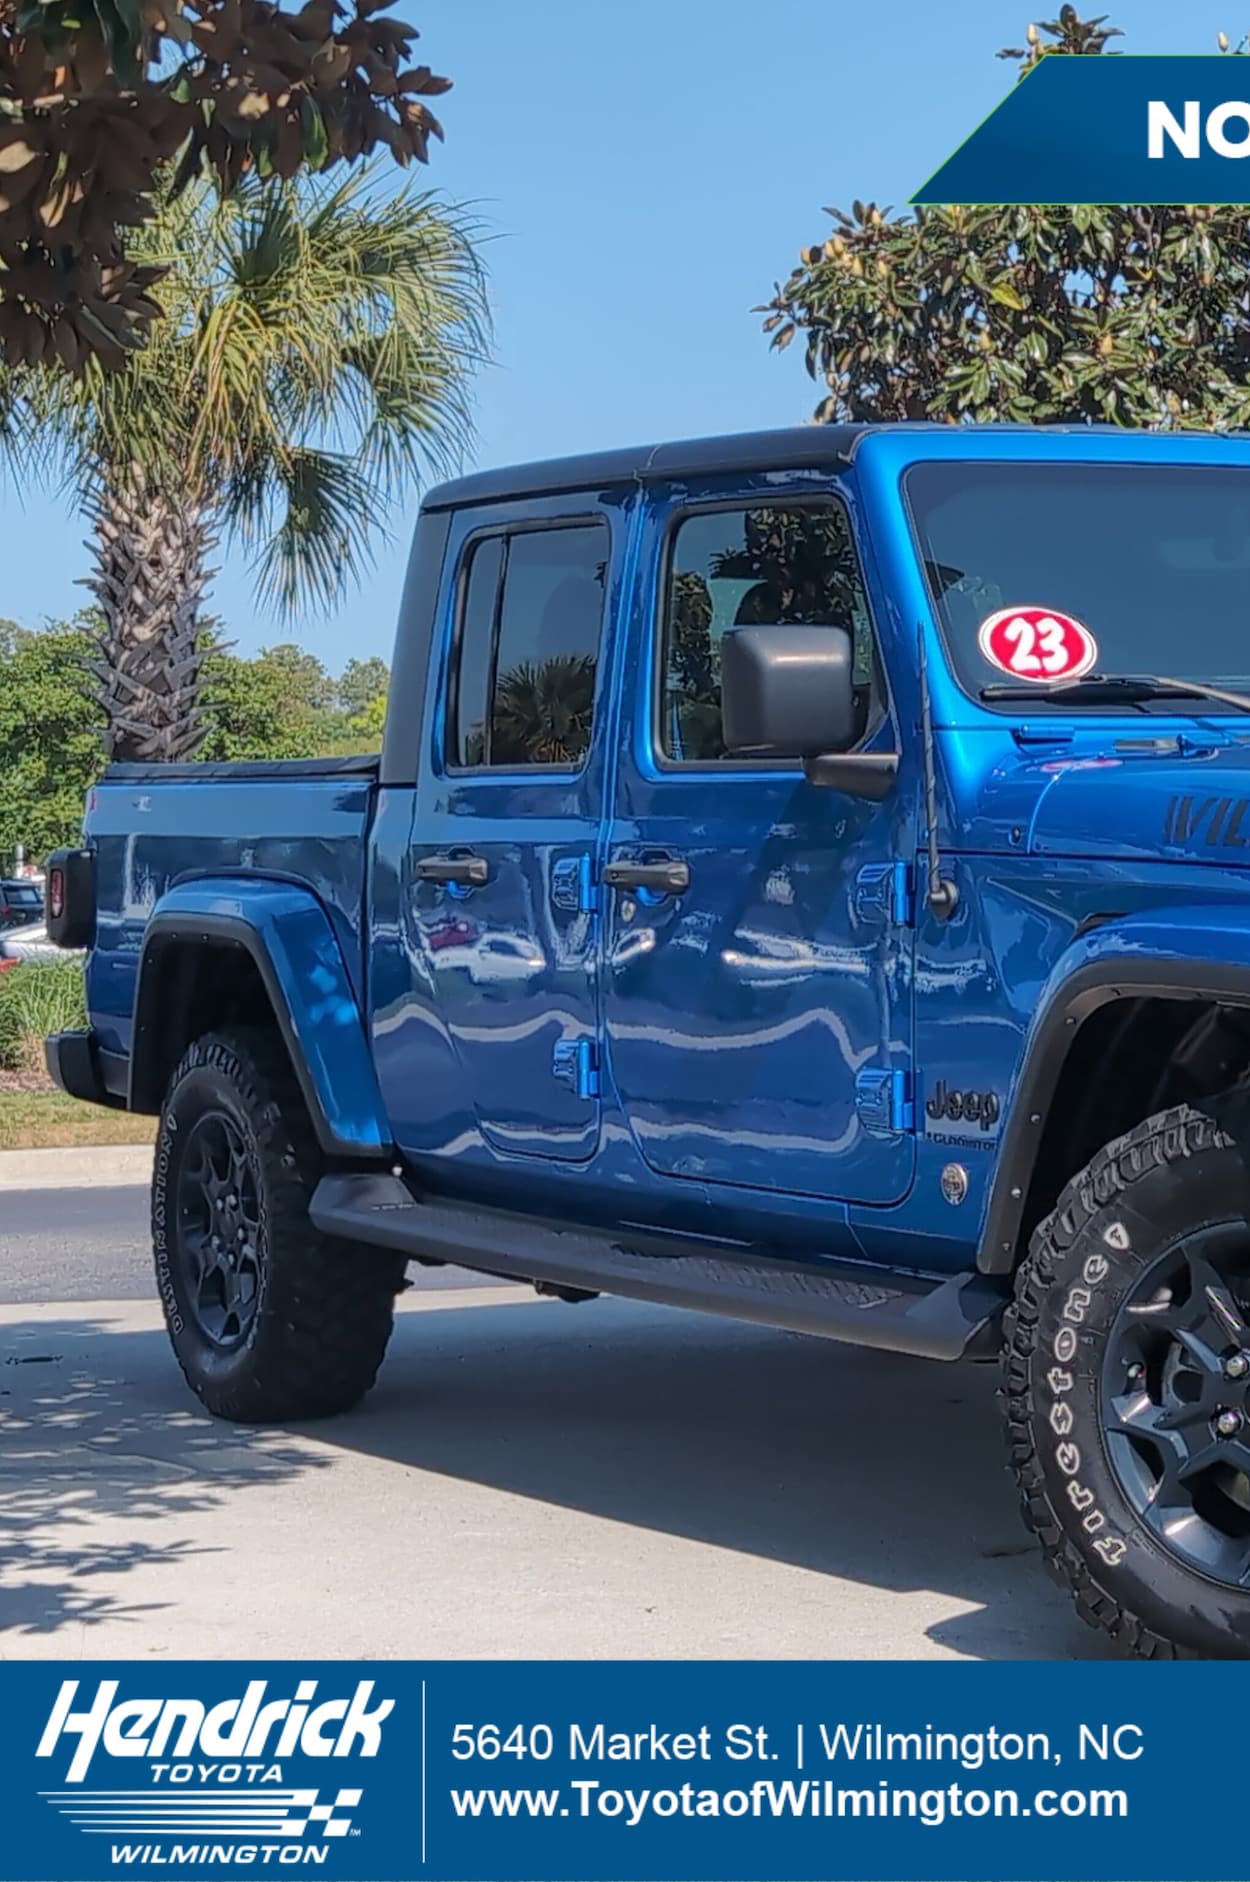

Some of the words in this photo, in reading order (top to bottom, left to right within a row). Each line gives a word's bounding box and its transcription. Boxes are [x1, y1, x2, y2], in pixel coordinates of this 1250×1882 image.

[1003, 617, 1070, 672] 23
[926, 1080, 1000, 1131] Jeep
[1048, 1254, 1126, 1565] Firestone
